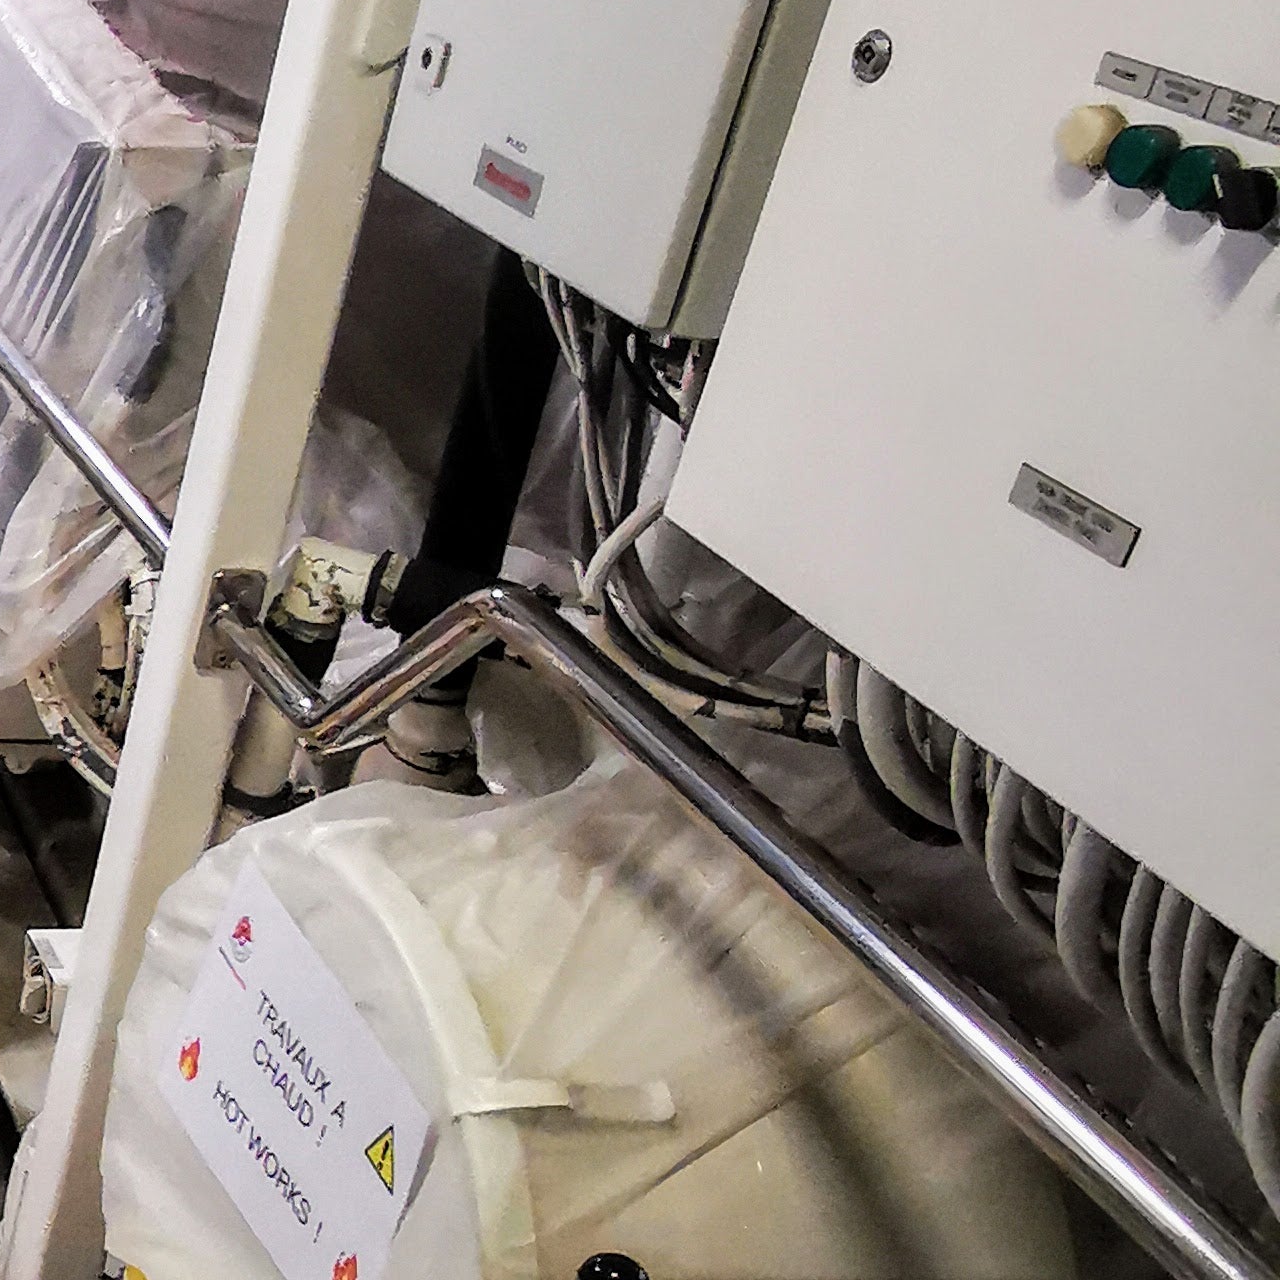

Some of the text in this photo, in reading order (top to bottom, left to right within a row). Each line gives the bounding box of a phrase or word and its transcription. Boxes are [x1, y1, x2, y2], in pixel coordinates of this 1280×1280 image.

[253, 1039, 314, 1127] CHAUD
[257, 989, 332, 1104] TRAVAUX
[213, 1080, 250, 1134] HOT
[248, 1126, 311, 1225] WORKS
